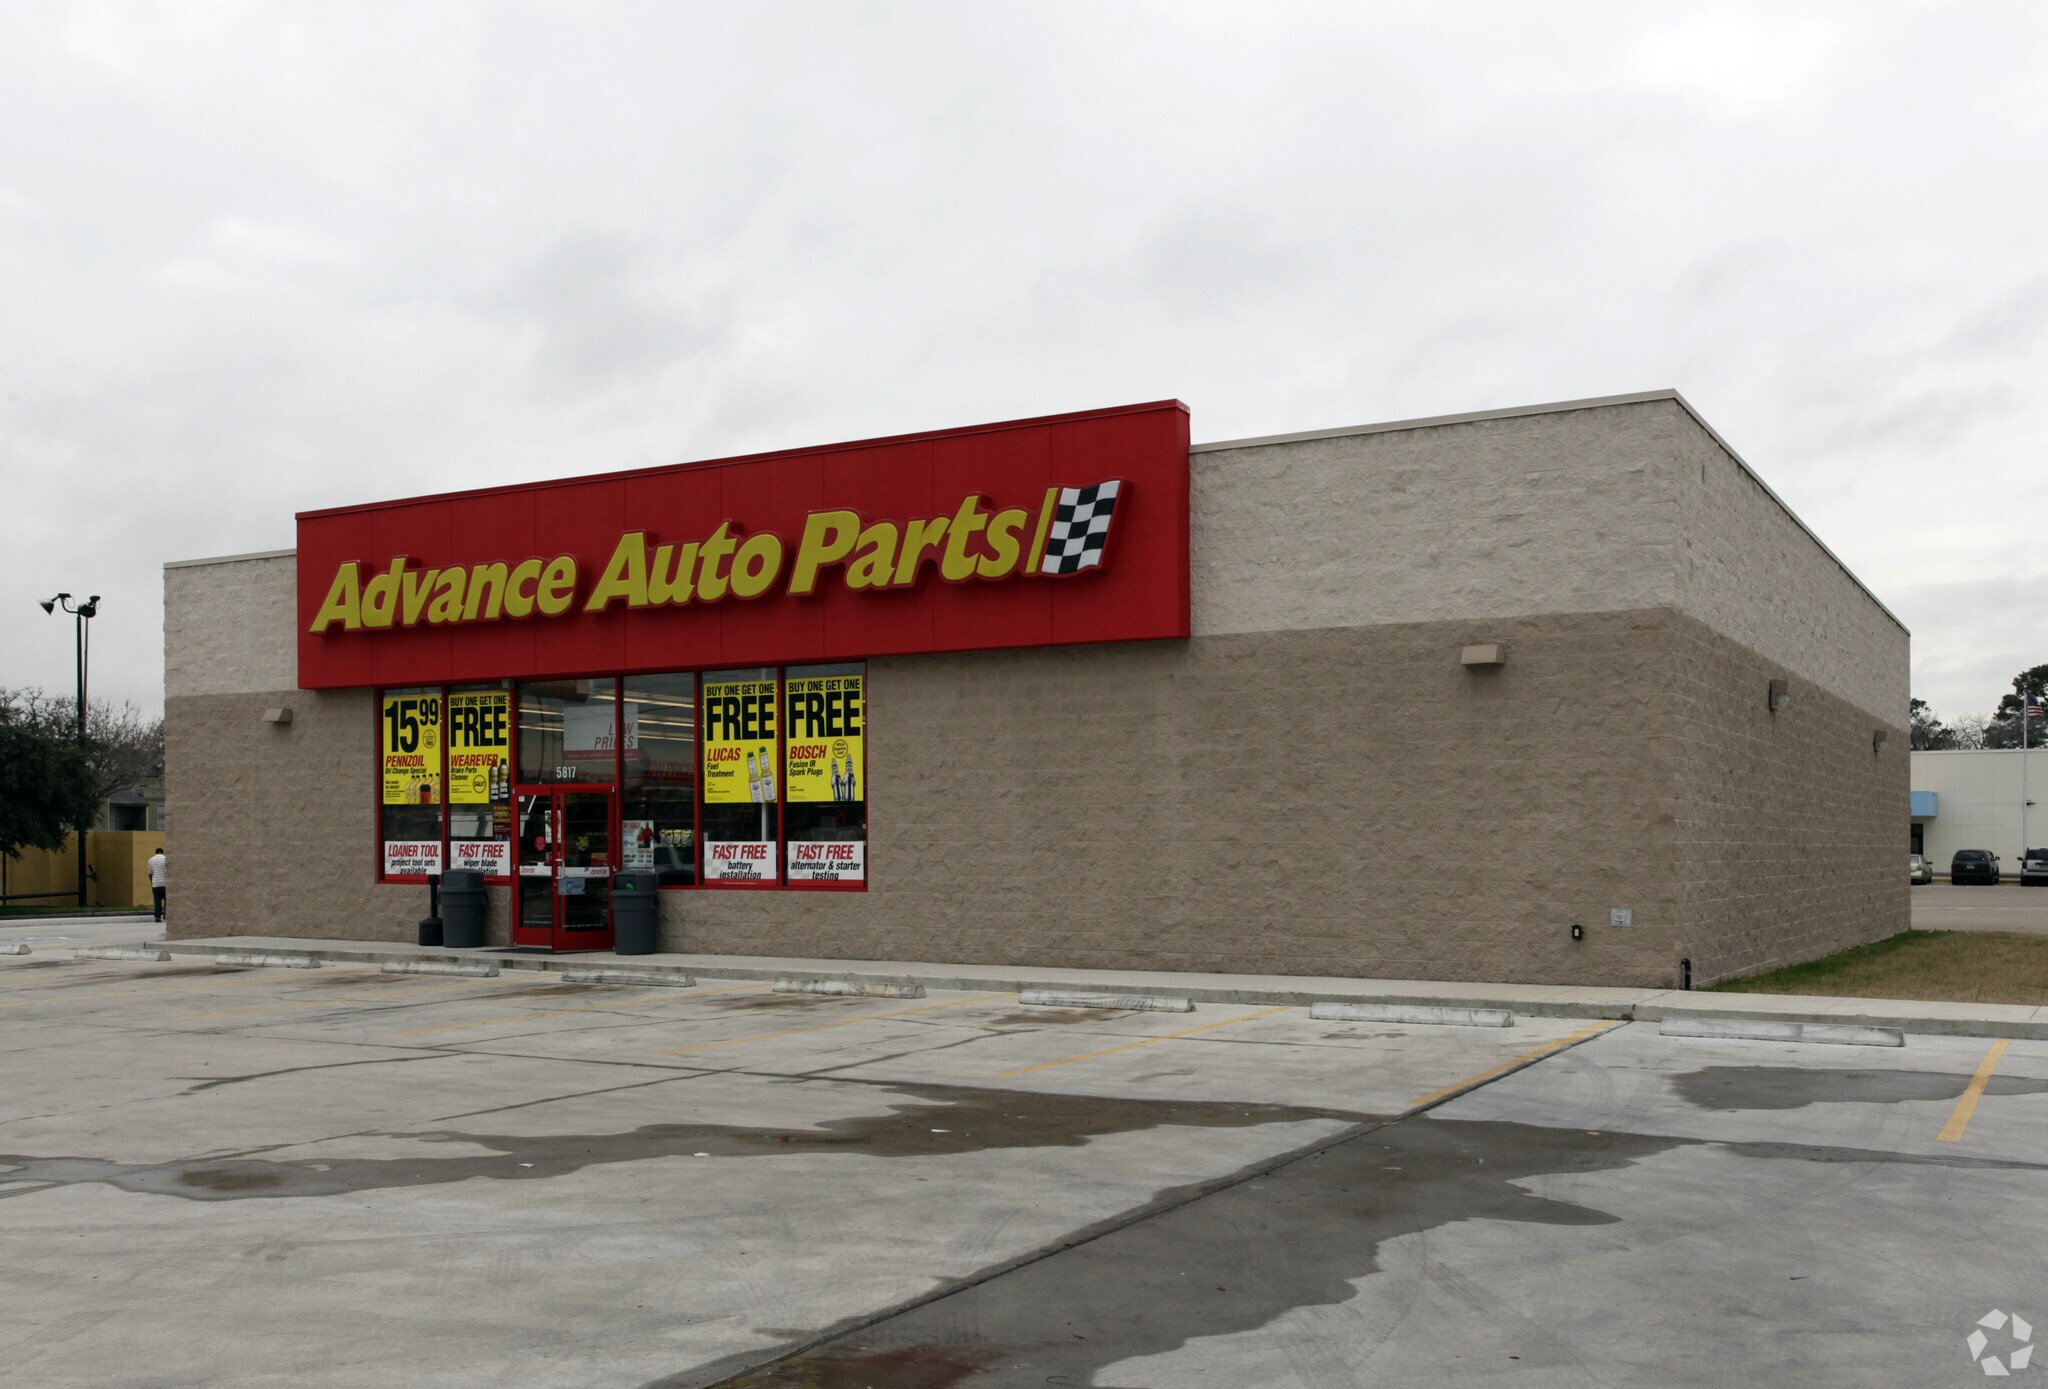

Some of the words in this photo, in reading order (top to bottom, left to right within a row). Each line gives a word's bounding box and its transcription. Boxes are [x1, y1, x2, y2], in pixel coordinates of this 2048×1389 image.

[309, 556, 577, 633] Advance
[584, 521, 782, 611] Auto
[788, 495, 1028, 594] Parts
[706, 686, 722, 697] BUY
[724, 685, 739, 695] ONE
[741, 684, 756, 694] GET
[759, 683, 774, 694] ONE
[788, 682, 805, 692] BUY
[808, 681, 823, 691] ONE
[826, 680, 841, 690] GET
[844, 679, 860, 689] ONE
[451, 697, 463, 706] BUY
[466, 697, 477, 706] ONE
[480, 696, 491, 705] GET
[494, 695, 506, 705] ONE
[706, 694, 775, 742] FREE
[788, 690, 861, 739] FREE
[450, 705, 507, 747] FREE
[609, 723, 634, 736] LW
[707, 748, 741, 761] LUCAS
[789, 745, 827, 759] BOSCH
[386, 755, 425, 767] PENNZOIL
[451, 754, 498, 767] WEAREVER
[789, 760, 809, 768] Fusion
[810, 760, 816, 768] IR
[556, 766, 576, 778] 5817
[789, 769, 805, 778] Spark
[807, 768, 823, 777] Plugs
[388, 845, 418, 857] LOANER
[420, 844, 439, 857] TOOL
[458, 845, 481, 857] FAST
[482, 844, 504, 858] FREE
[712, 845, 738, 859] FAST
[740, 845, 767, 859] FREE
[796, 845, 822, 860] FAST
[826, 845, 854, 860] FREE
[391, 859, 411, 867] project
[464, 859, 480, 868] wiper
[728, 861, 753, 871] battery
[791, 861, 826, 870] alternator
[828, 861, 834, 870] &
[836, 862, 861, 870] starter
[720, 871, 762, 879] installation
[812, 871, 839, 881] testing
